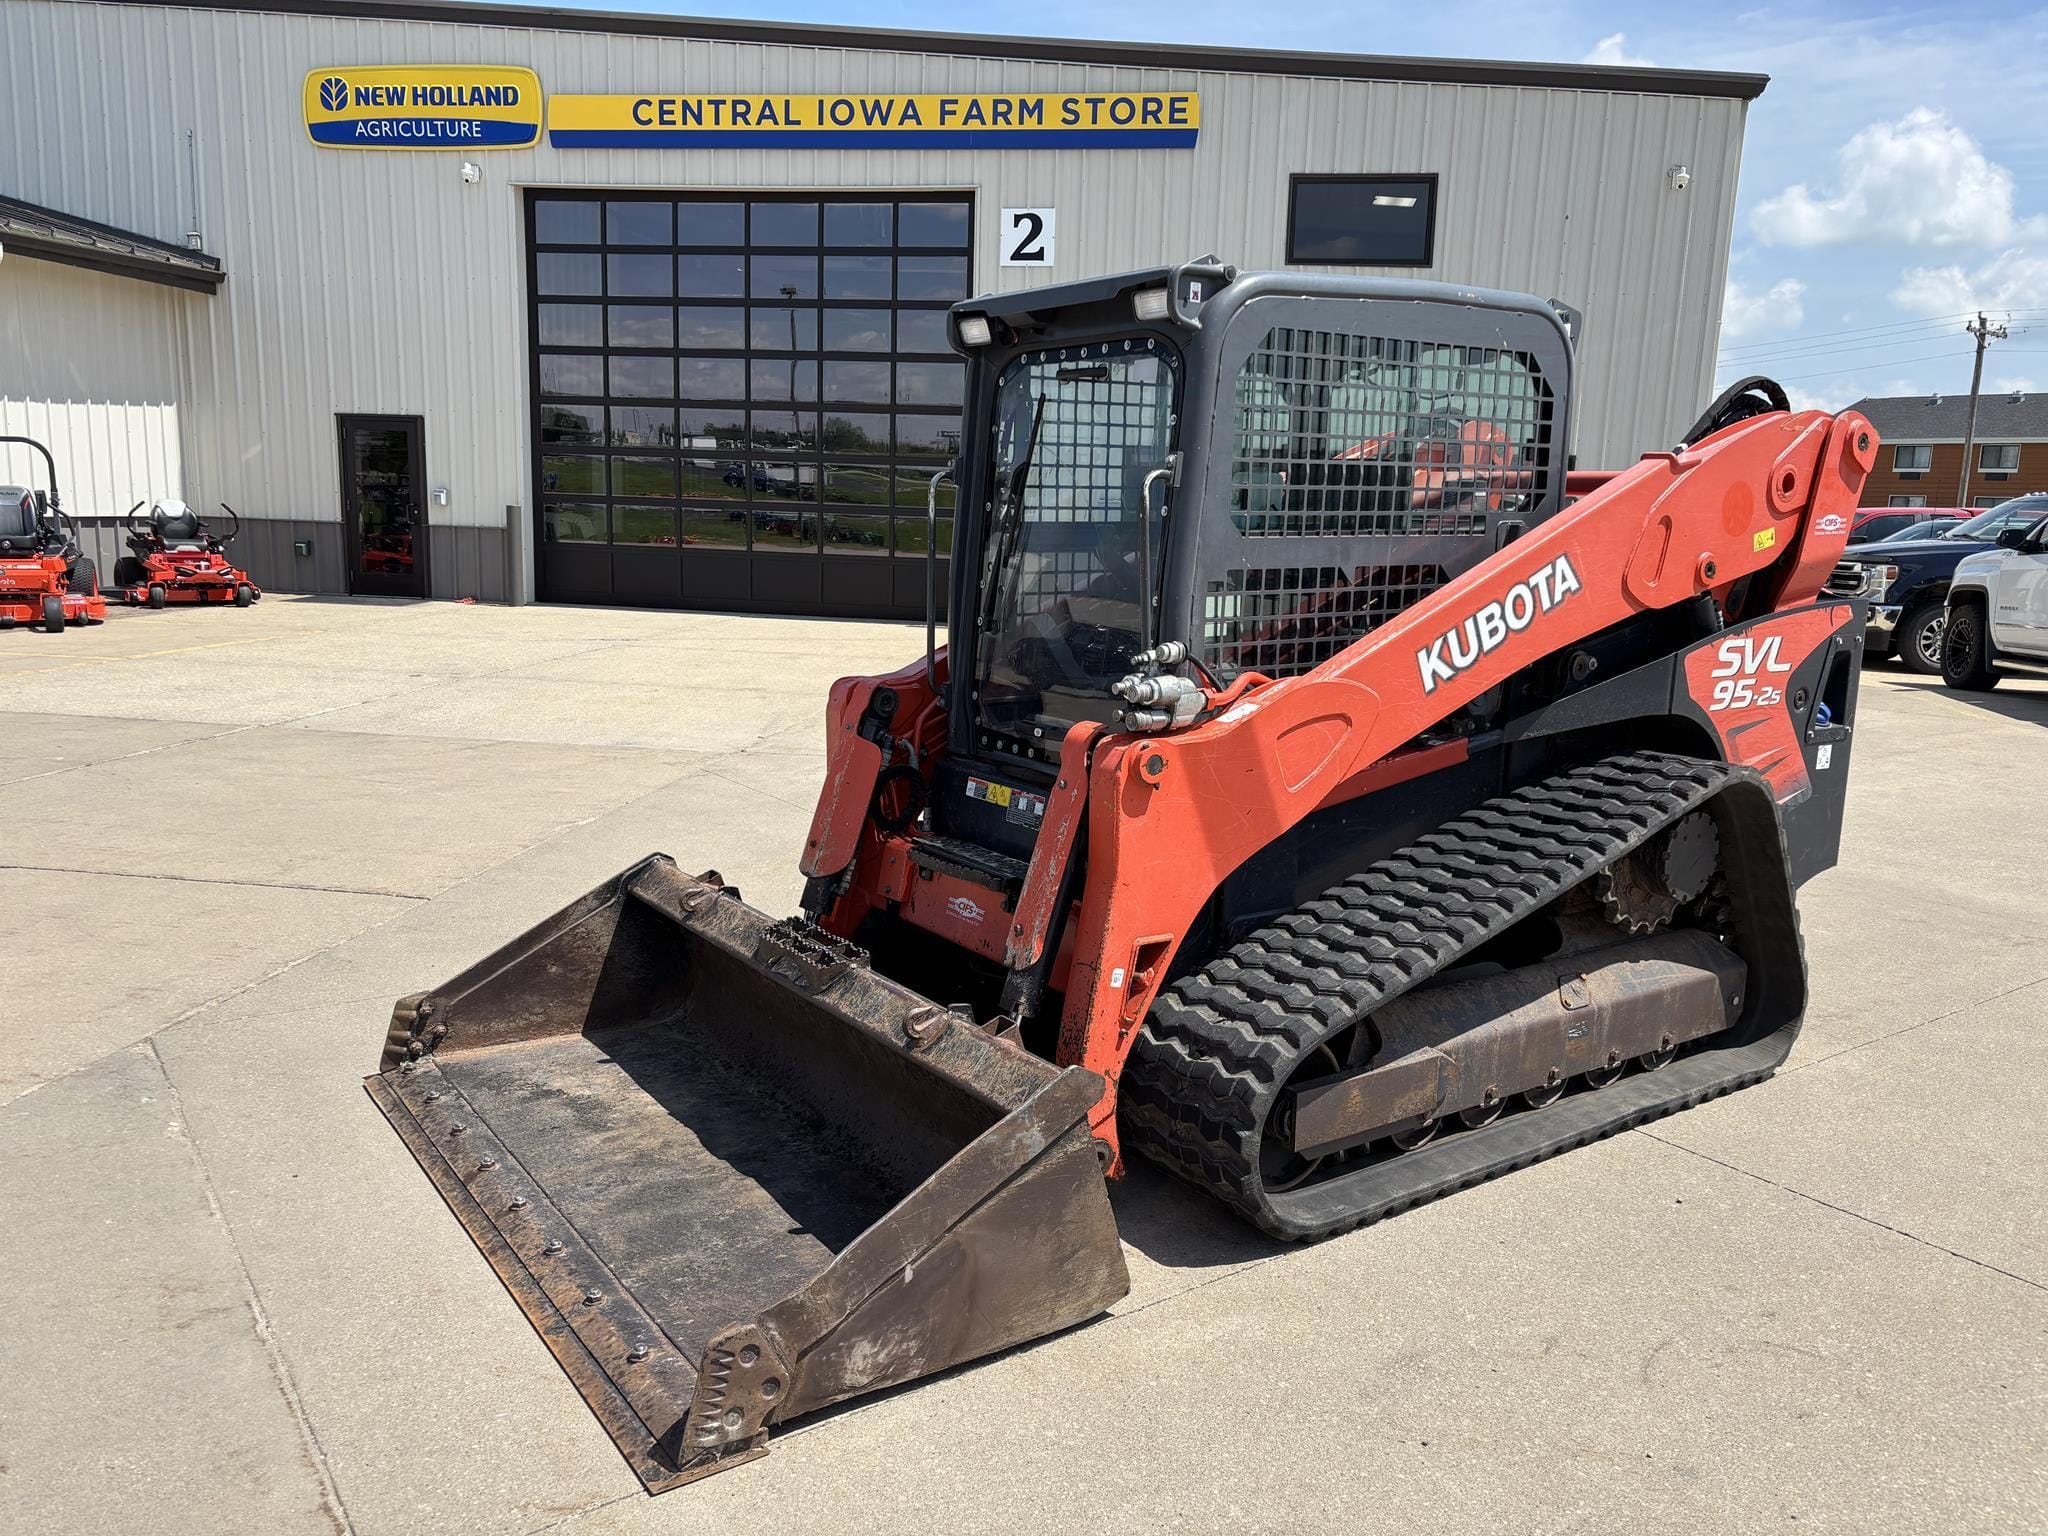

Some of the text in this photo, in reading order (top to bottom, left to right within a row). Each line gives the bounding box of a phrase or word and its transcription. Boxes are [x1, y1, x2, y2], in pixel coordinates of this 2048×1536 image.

[355, 85, 519, 107] NEW HOLLAND
[632, 97, 1189, 126] CENTRAL IOWA FARM STORE
[355, 121, 482, 137] AGRICULTURE
[1010, 213, 1045, 261] 2
[1416, 554, 1581, 695] KUBOTA
[1711, 636, 1792, 678] SVL
